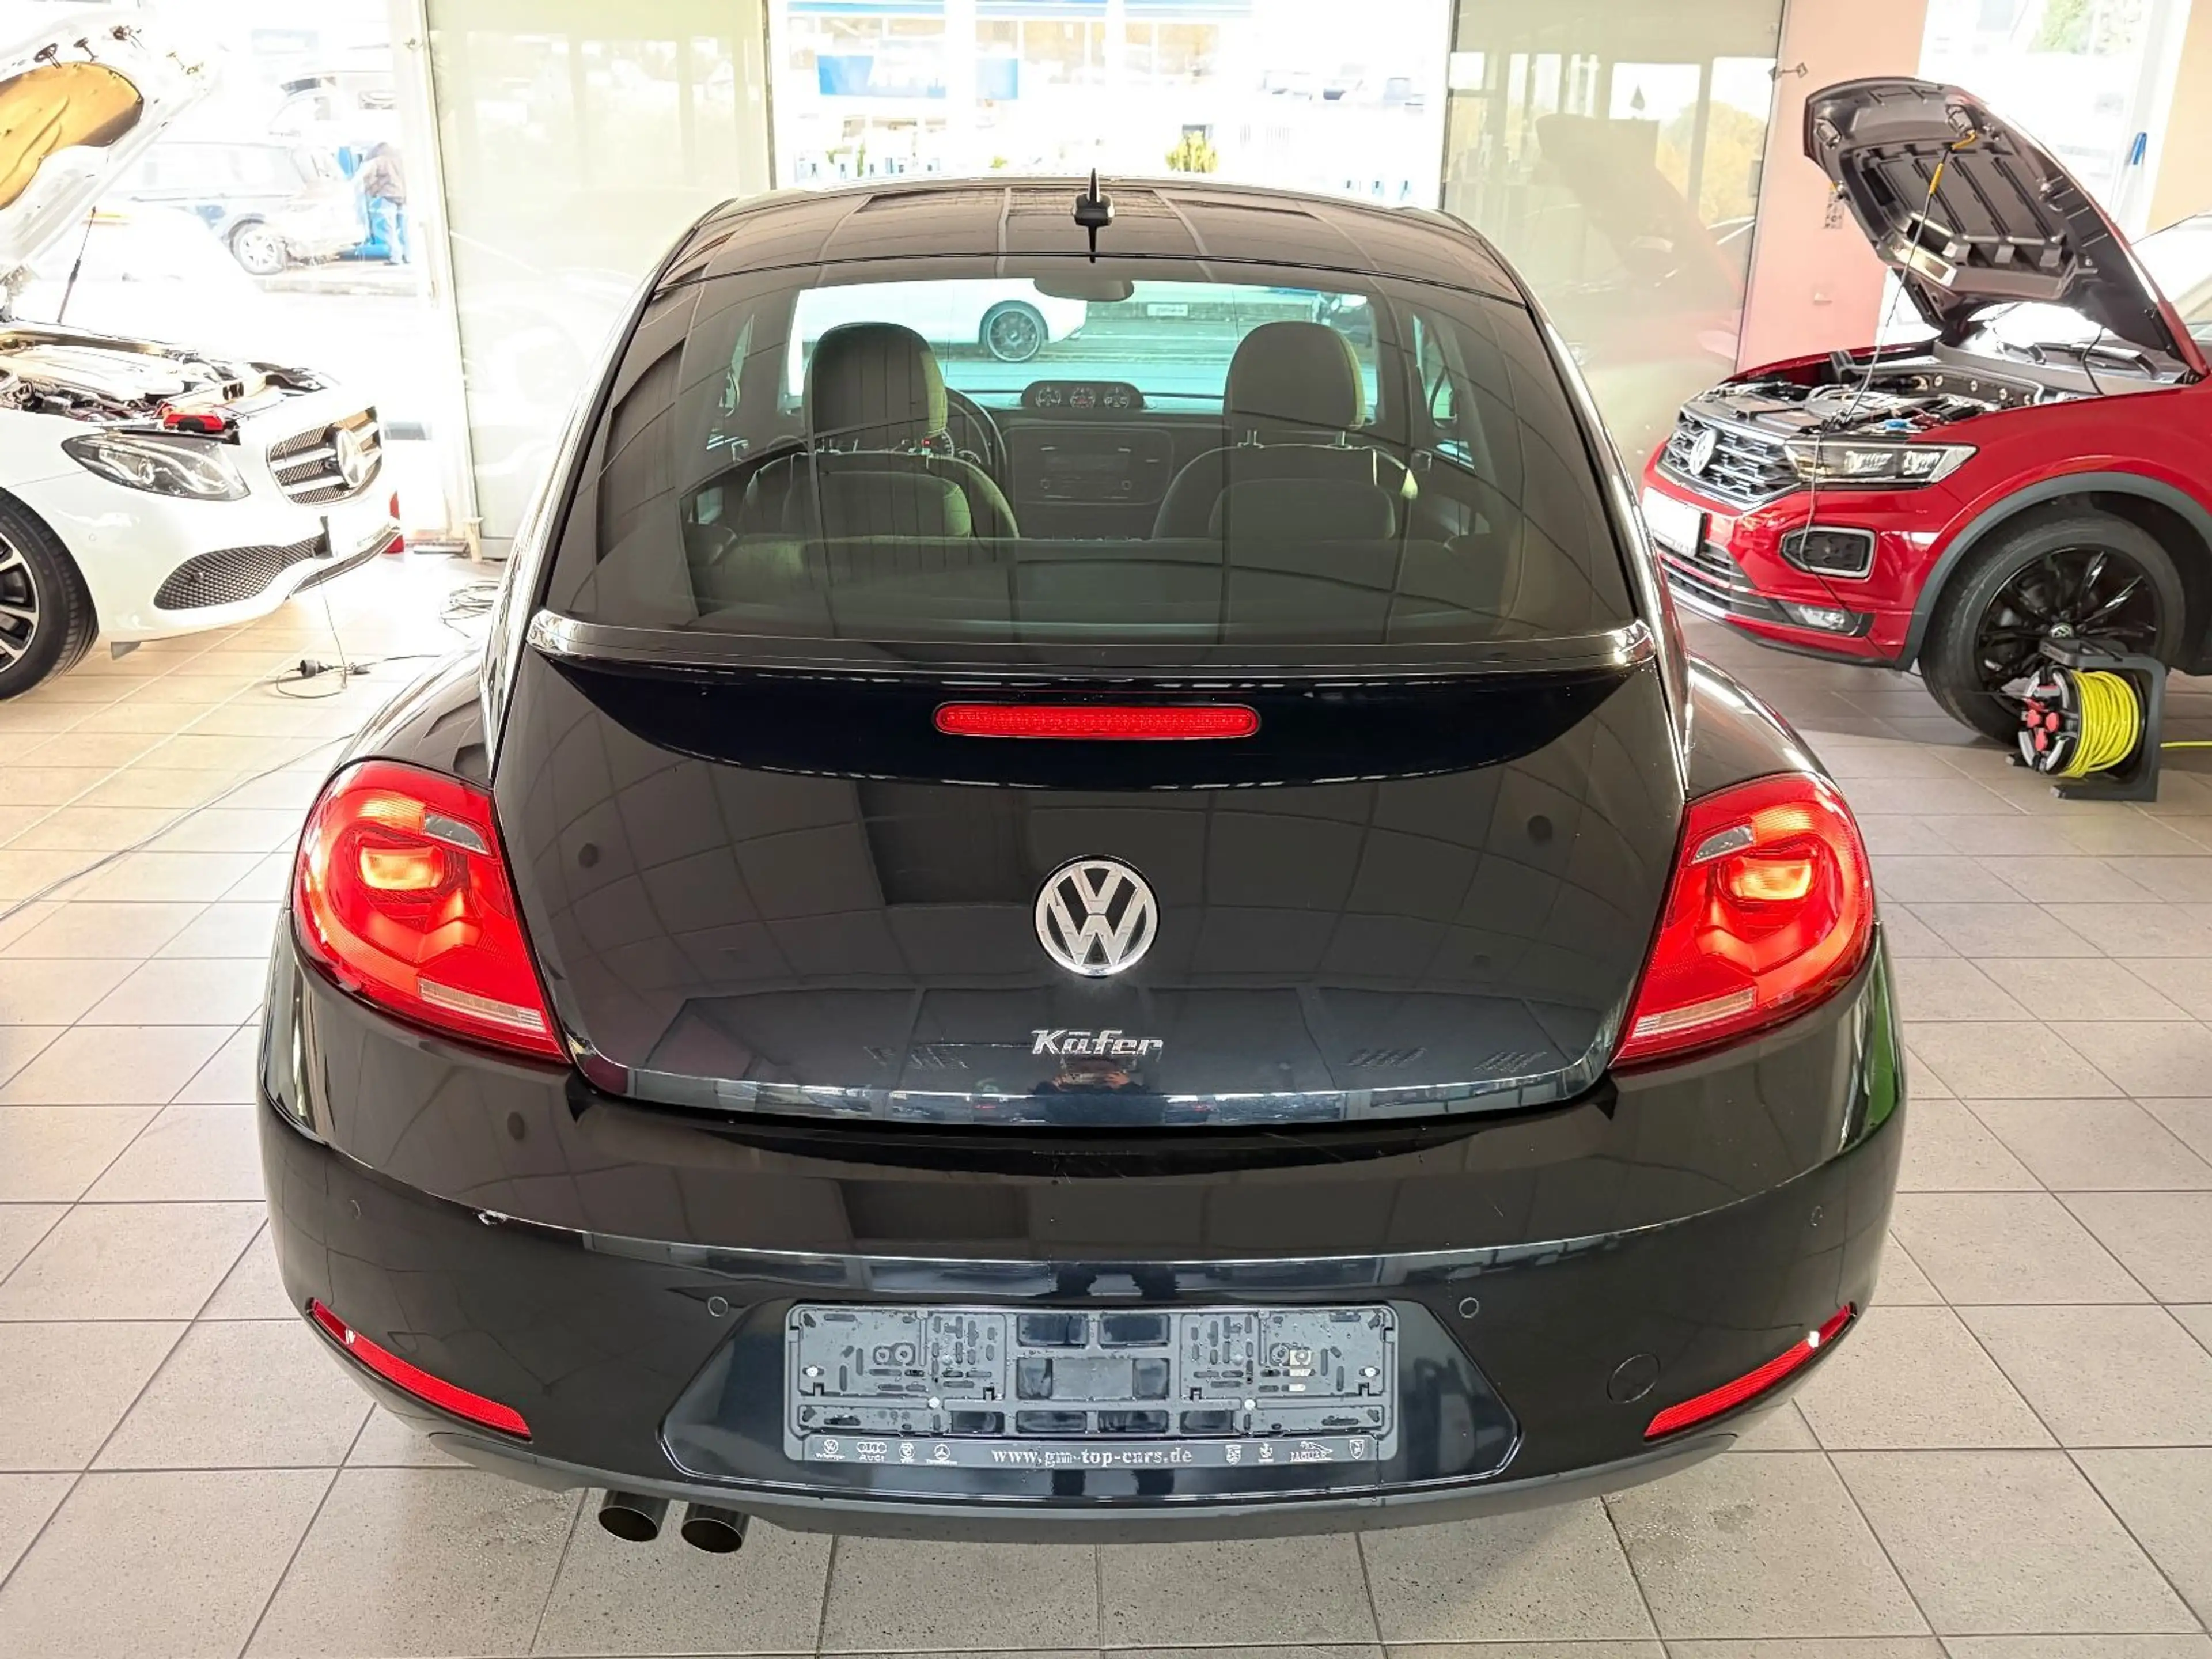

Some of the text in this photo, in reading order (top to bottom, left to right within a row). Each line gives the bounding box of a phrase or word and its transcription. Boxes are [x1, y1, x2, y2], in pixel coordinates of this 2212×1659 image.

[1039, 861, 1156, 973] VW
[1031, 1029, 1164, 1055] Käfer
[991, 1447, 1193, 1467] www.gm-top-cars.de
